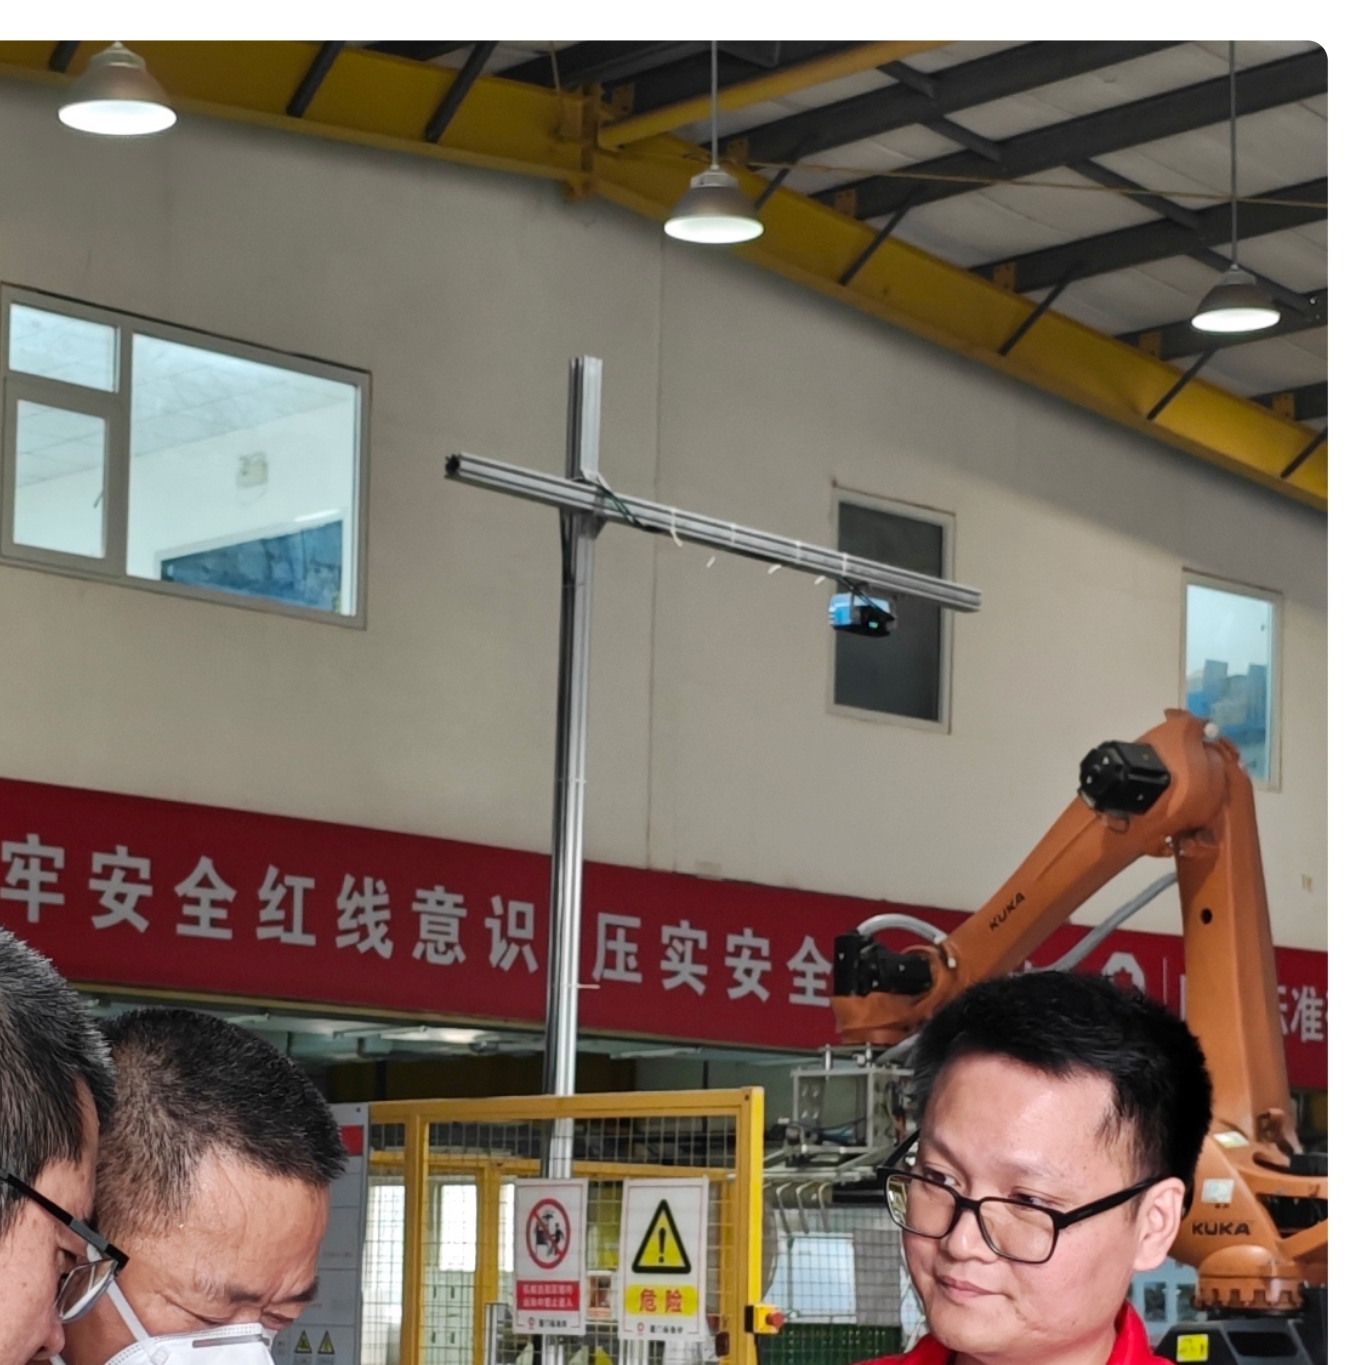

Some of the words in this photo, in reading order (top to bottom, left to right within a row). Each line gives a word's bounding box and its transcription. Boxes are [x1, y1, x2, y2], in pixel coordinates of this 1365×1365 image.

[989, 891, 1027, 930] KUKA
[1191, 1220, 1253, 1236] KUKA
[639, 1288, 683, 1314] 危险
